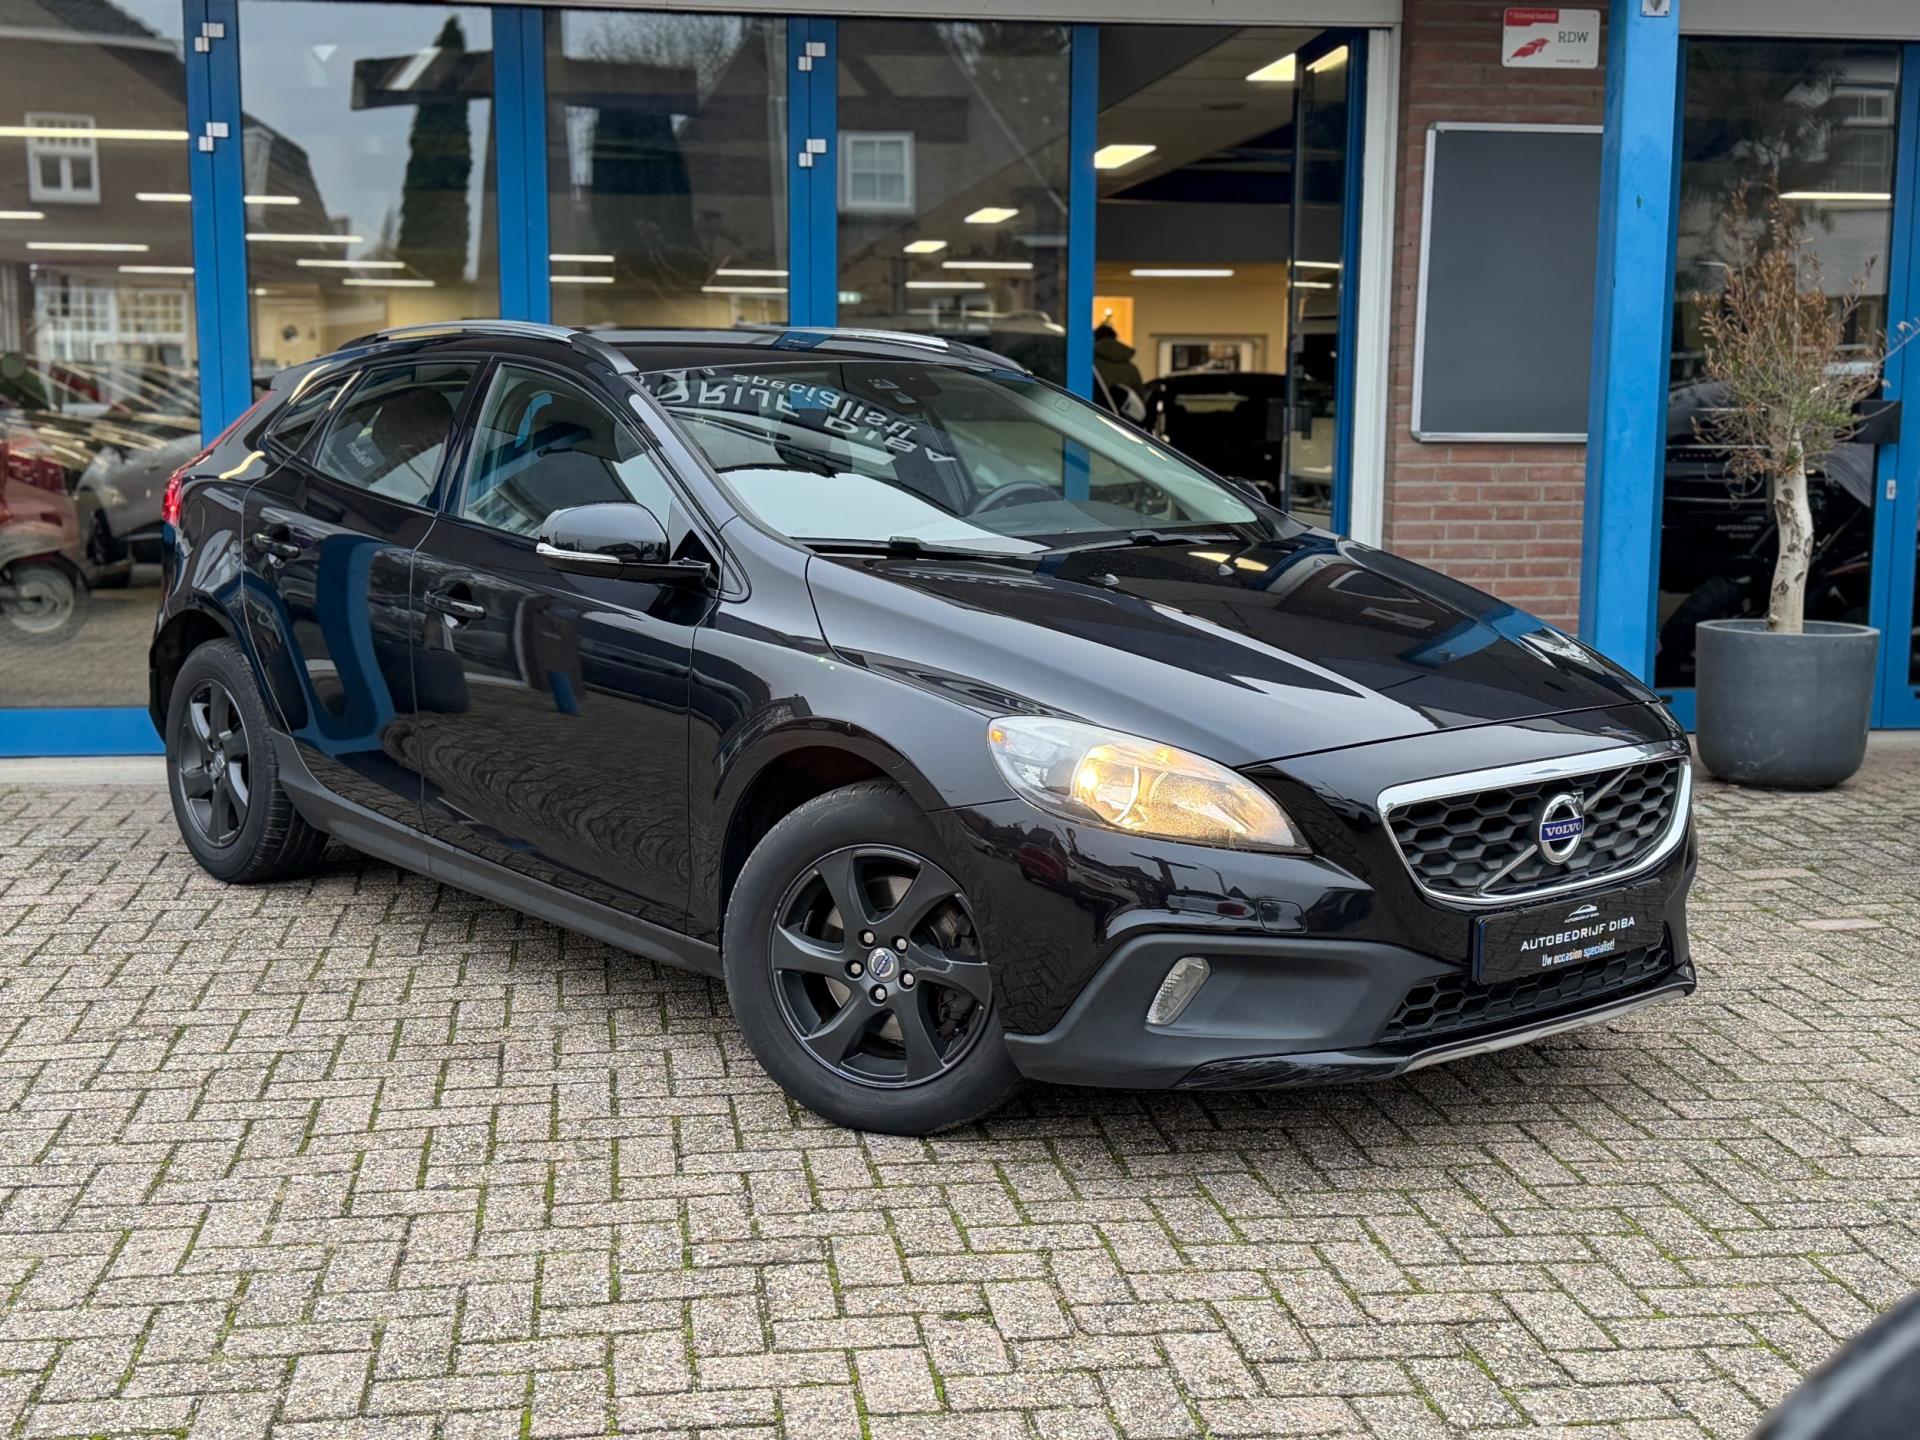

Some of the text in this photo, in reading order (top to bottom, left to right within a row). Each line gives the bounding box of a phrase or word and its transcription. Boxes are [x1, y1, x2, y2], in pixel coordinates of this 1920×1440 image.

[1557, 31, 1589, 43] RDW
[1545, 822, 1582, 837] VOLVO
[1520, 916, 1636, 952] AUTOBEDRIJF DIBA
[1541, 938, 1616, 967] Uw occasion specialist!
